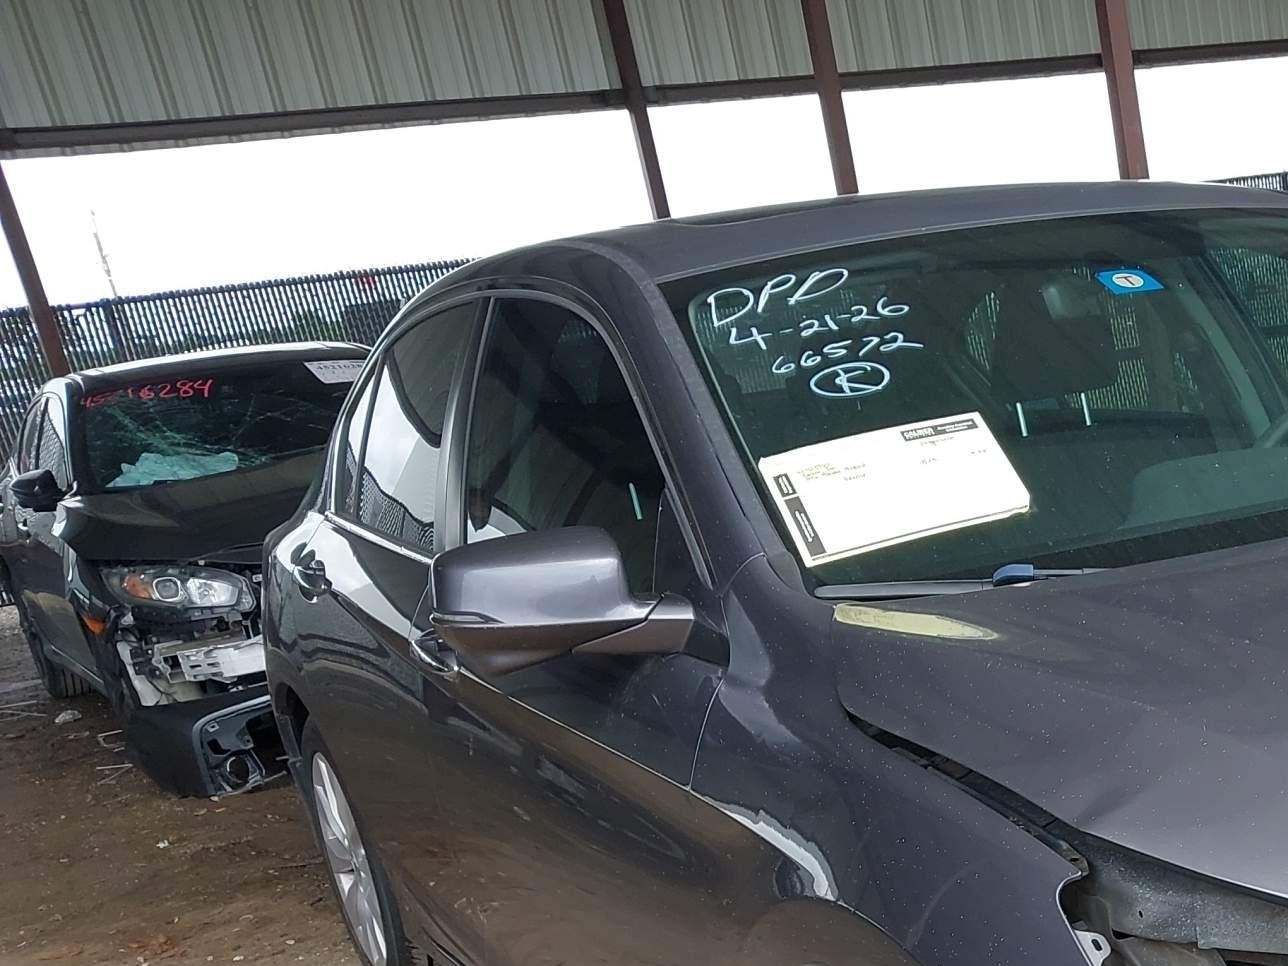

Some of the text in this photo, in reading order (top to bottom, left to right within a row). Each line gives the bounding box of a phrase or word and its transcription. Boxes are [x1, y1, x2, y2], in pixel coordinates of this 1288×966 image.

[707, 268, 849, 327] DPD
[729, 296, 910, 350] 4-21-26
[771, 332, 924, 375] 66572
